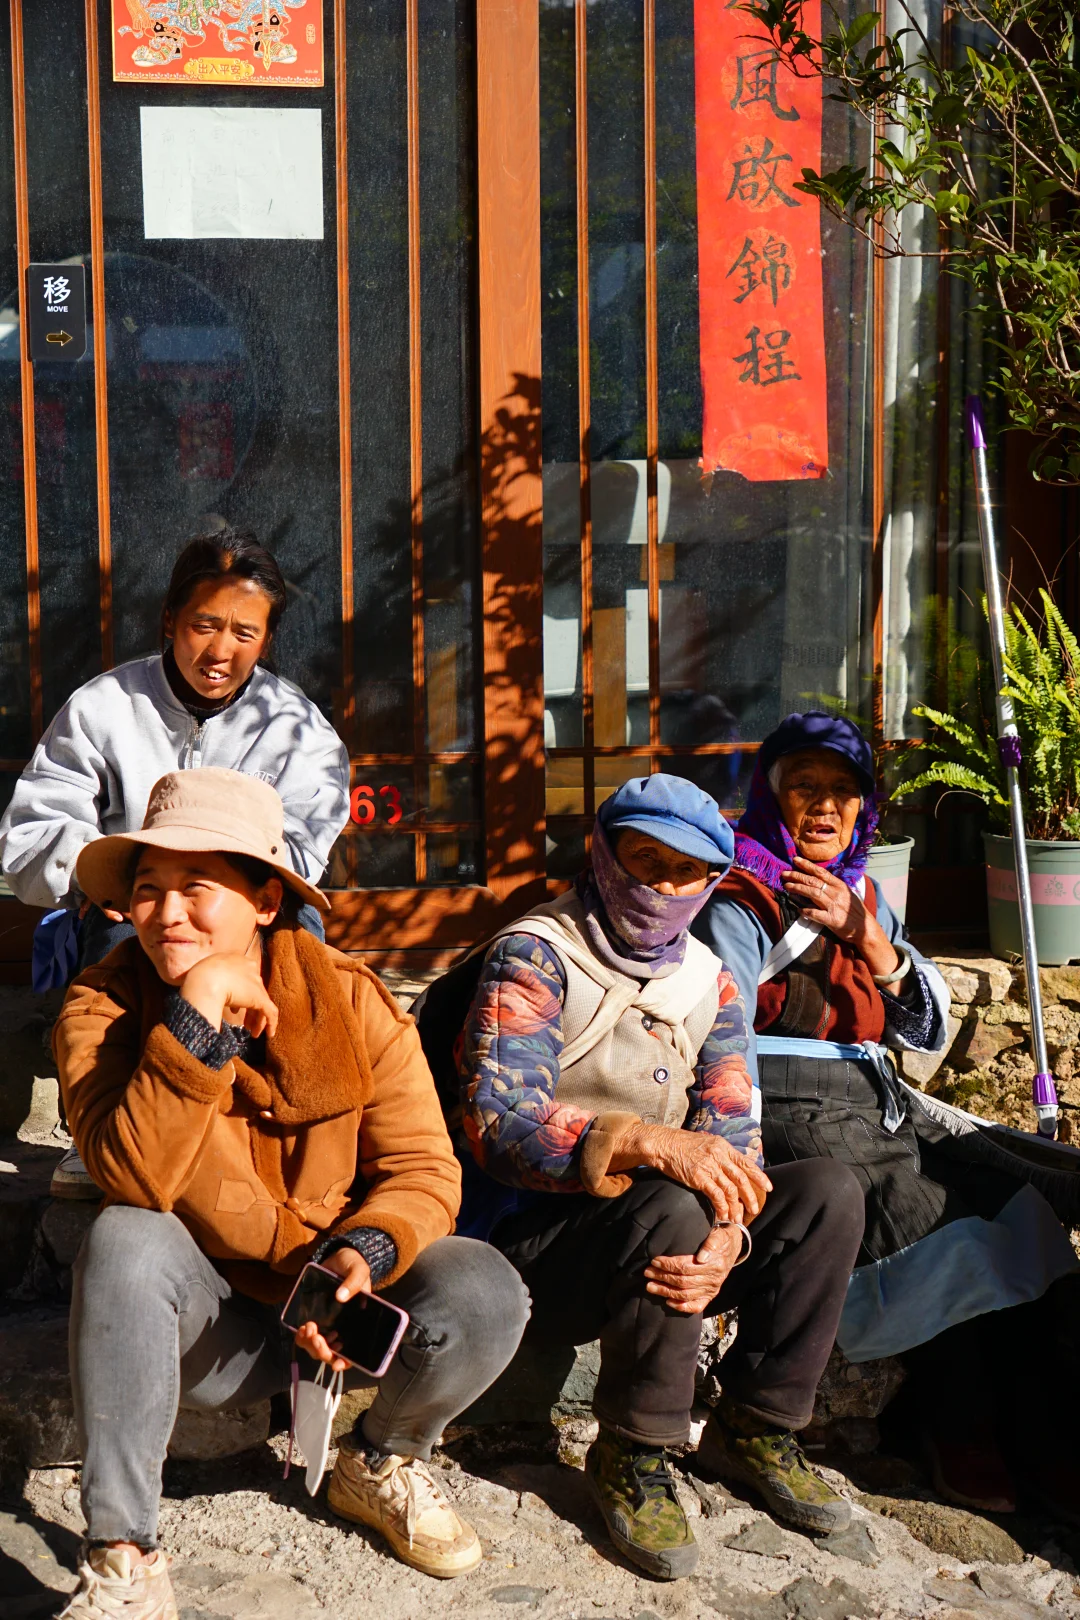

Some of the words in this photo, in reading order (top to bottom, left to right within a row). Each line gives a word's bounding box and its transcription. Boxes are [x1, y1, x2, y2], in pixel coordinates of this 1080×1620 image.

[198, 63, 241, 75] 出入平安
[724, 0, 802, 388] 風啟錦程
[43, 276, 71, 304] 移
[350, 785, 402, 825] 63
